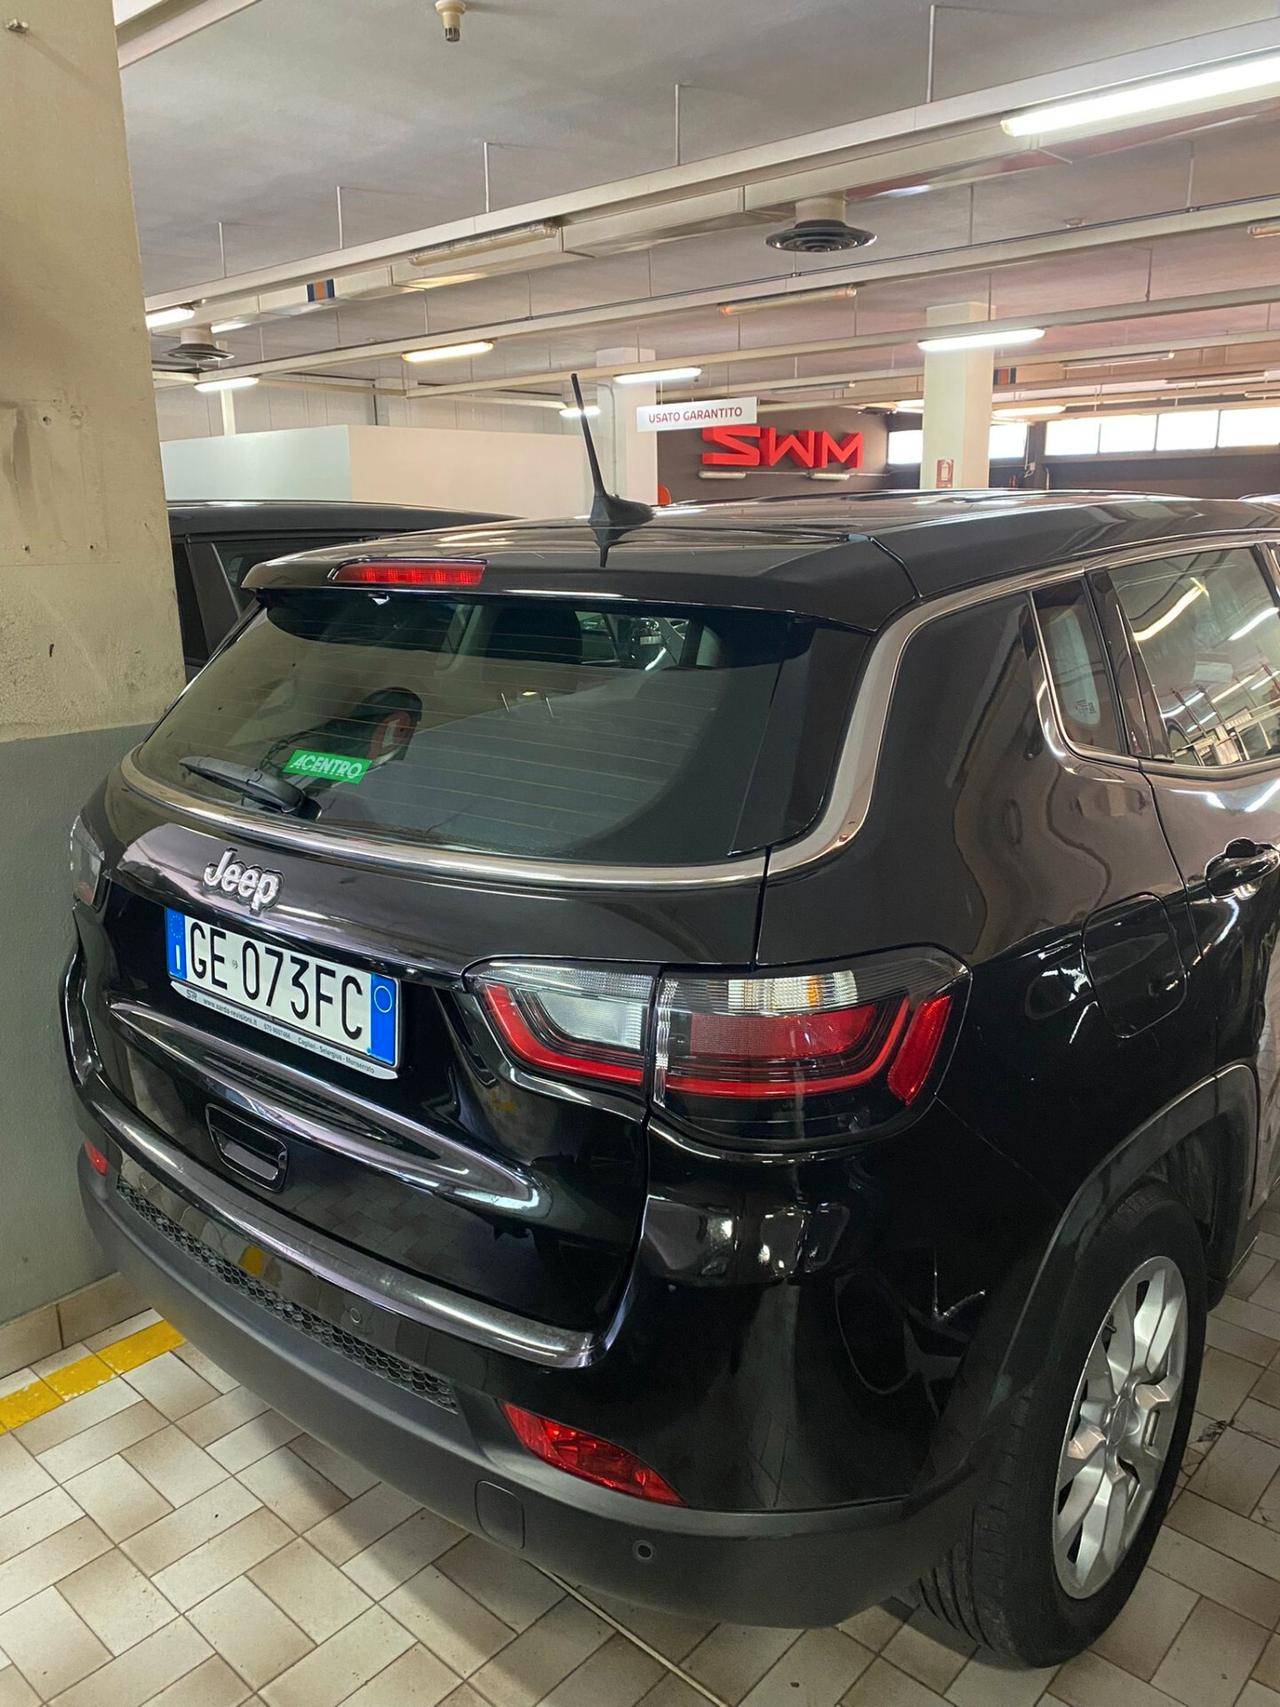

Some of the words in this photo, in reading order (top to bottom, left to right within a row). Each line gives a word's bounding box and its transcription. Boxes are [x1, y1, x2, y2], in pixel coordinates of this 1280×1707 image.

[648, 410, 681, 424] USATO
[683, 406, 743, 422] GARANTITO
[701, 423, 864, 470] SWM
[290, 753, 363, 779] ACENTRO
[203, 848, 283, 913] Jeep
[189, 921, 228, 990] GE
[242, 940, 363, 1040] 073FC
